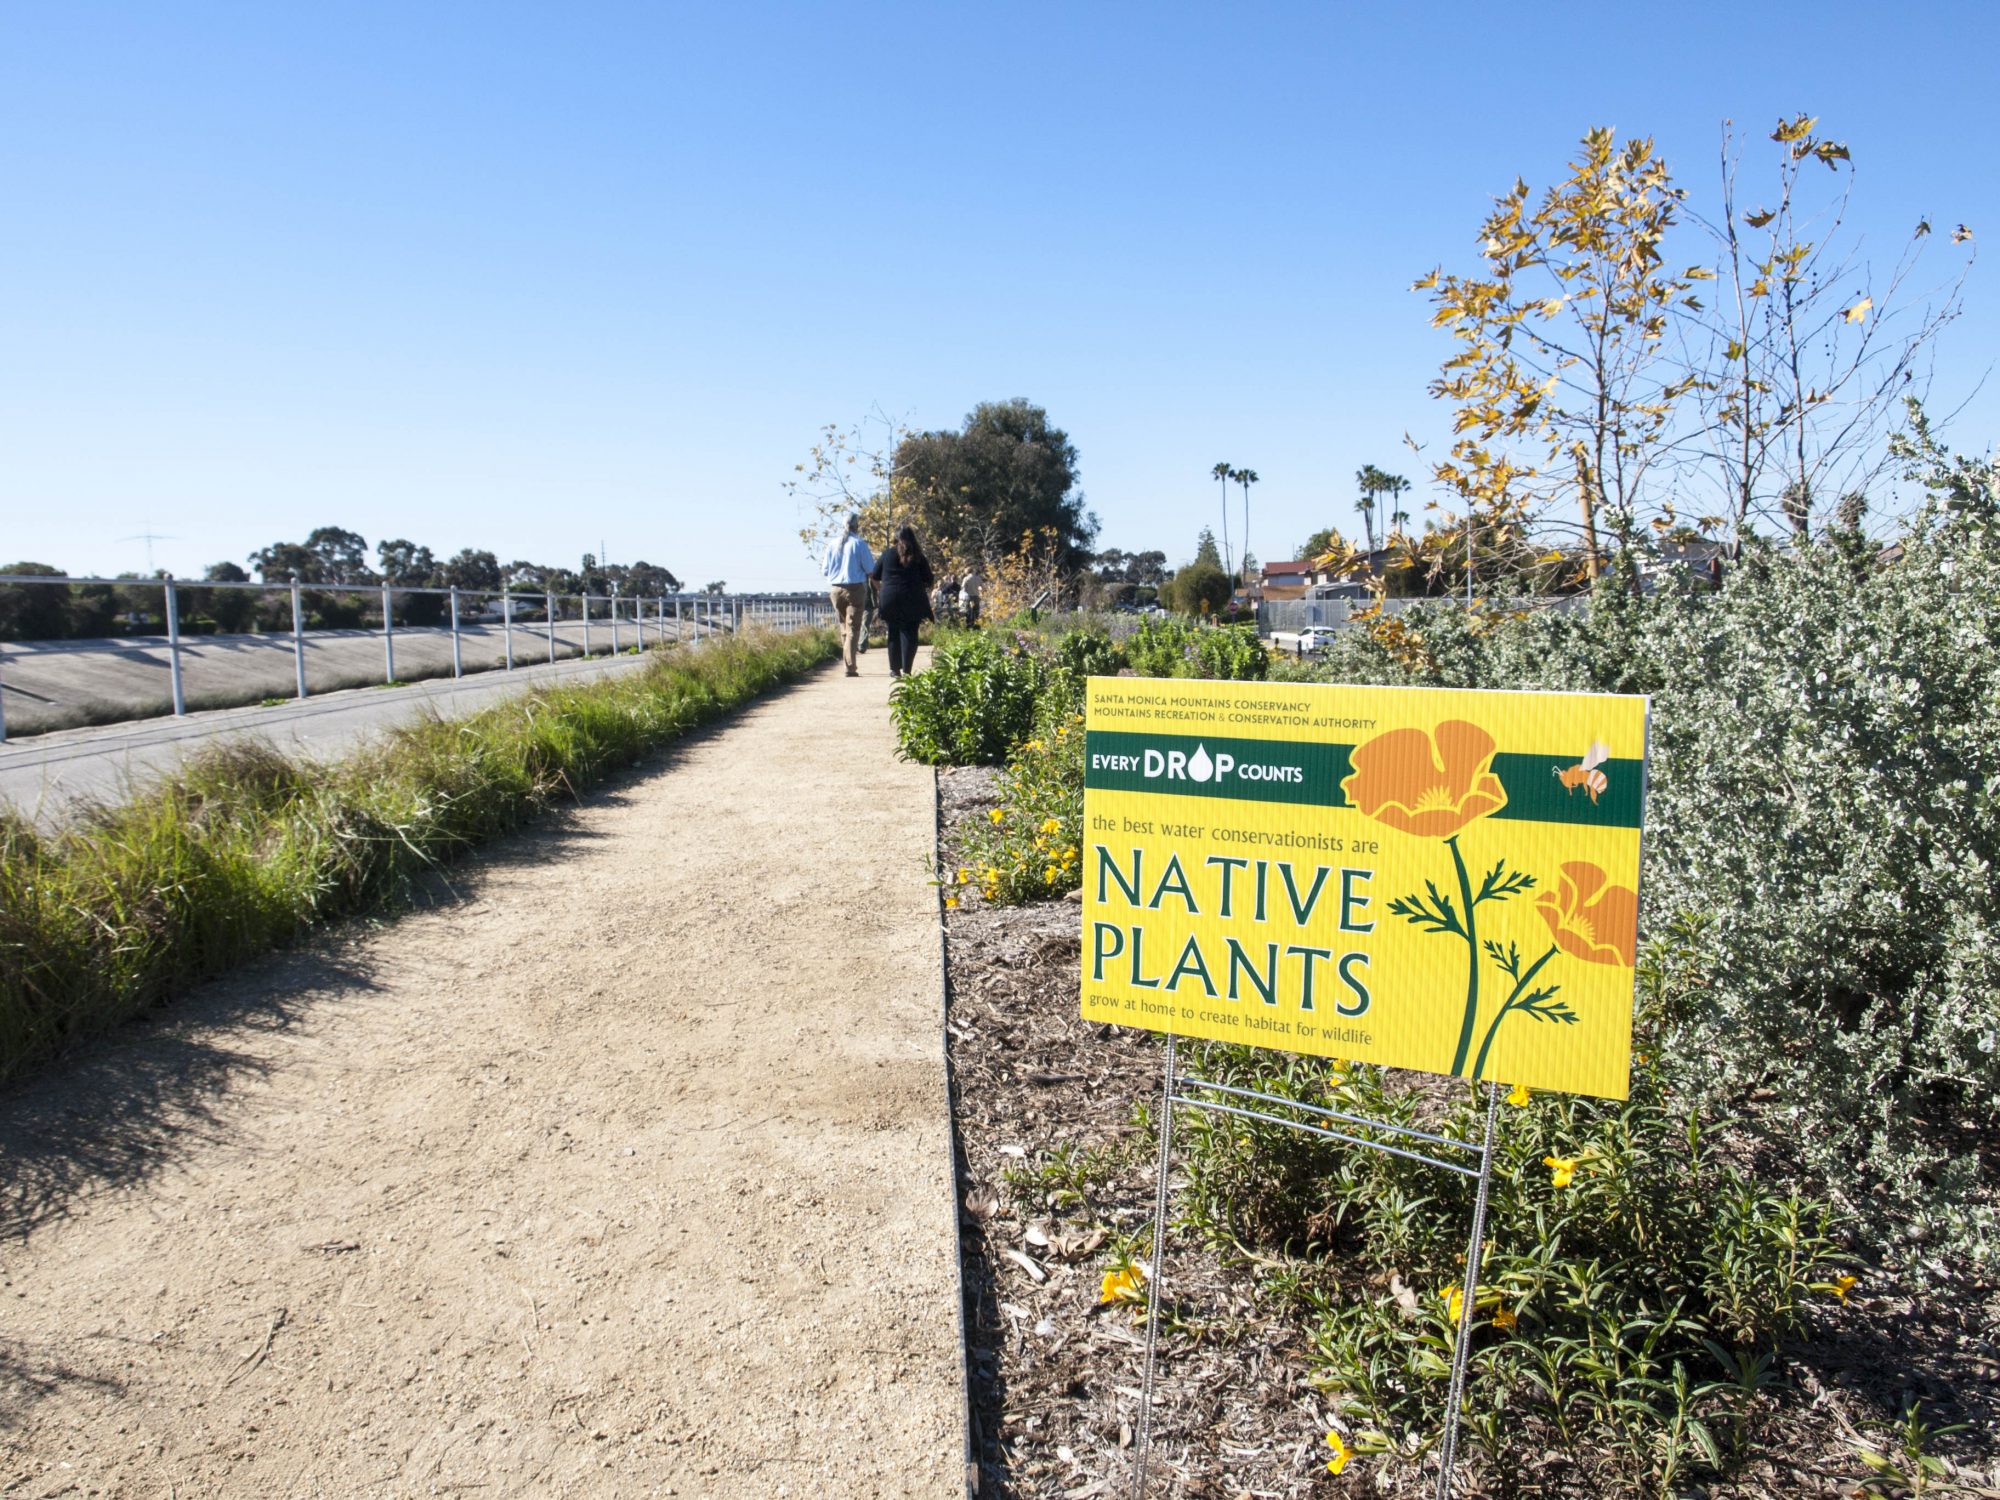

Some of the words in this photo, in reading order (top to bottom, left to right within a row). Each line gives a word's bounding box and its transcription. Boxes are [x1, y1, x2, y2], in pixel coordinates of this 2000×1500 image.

[1094, 694, 1124, 704] SANTA
[1128, 695, 1167, 706] MONICA
[1170, 697, 1231, 709] MOUNTAINS
[1234, 700, 1311, 712] CONSERVANCY
[1094, 707, 1152, 718] MOUNTAINS
[1155, 710, 1215, 721] RECREATION
[1219, 714, 1225, 722] &
[1228, 713, 1309, 726] CONSERVATION
[1313, 718, 1377, 729] AUTHORITY
[1092, 754, 1140, 771] EVERY
[1238, 764, 1303, 783] COUNTS
[1093, 814, 1116, 831] the
[1123, 817, 1153, 834] best
[1161, 823, 1204, 839] water
[1212, 827, 1343, 852] conservationists
[1351, 840, 1379, 854] are
[1094, 844, 1376, 934] NATIVE
[1092, 921, 1371, 1017] PLANTS
[1089, 994, 1119, 1007] grow
[1124, 999, 1136, 1010] at
[1140, 999, 1176, 1016] home
[1181, 1007, 1194, 1019] to
[1199, 1011, 1239, 1025] create
[1244, 1014, 1291, 1034] habitat
[1296, 1021, 1317, 1037] for
[1322, 1027, 1372, 1045] wildlife
